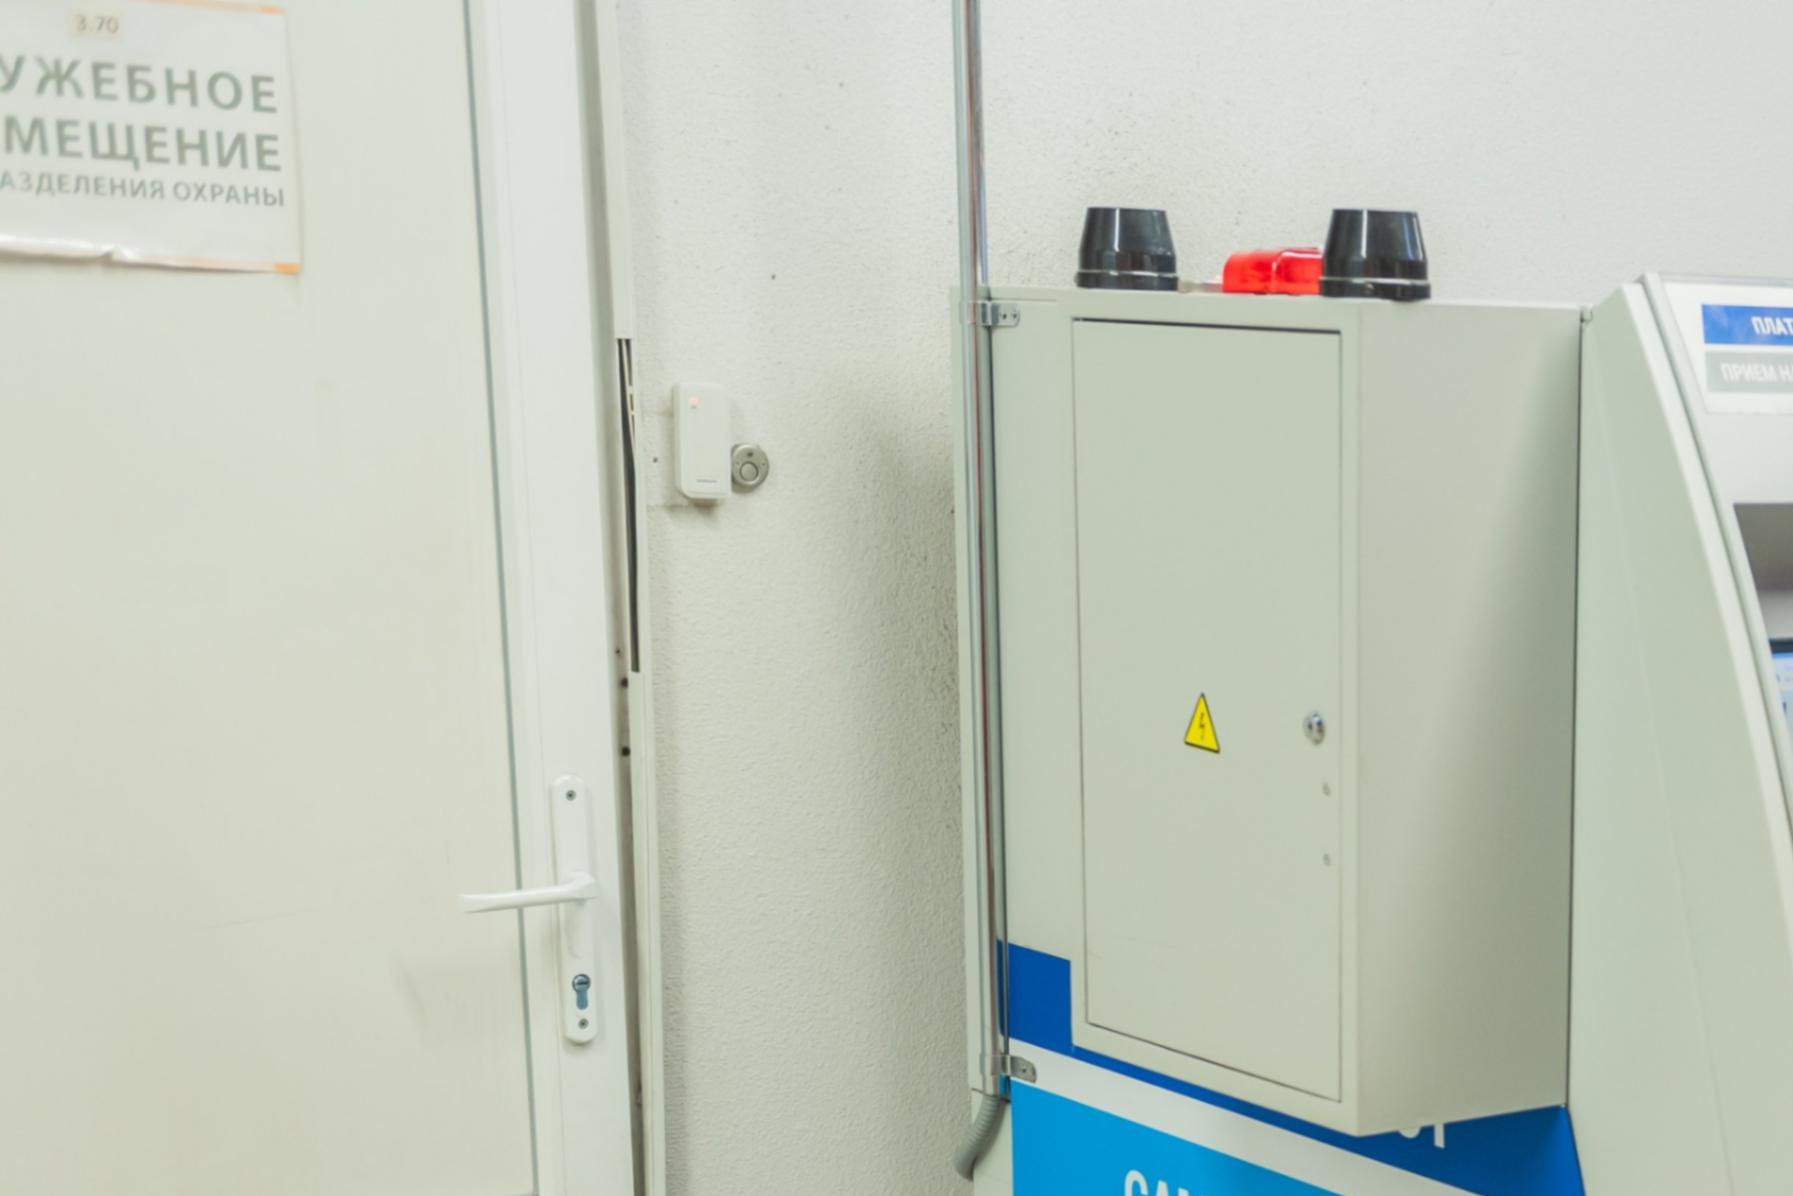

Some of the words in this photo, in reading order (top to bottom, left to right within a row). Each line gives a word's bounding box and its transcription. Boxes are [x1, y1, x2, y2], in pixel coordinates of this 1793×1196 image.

[3, 115, 283, 173] МЕЩЕНИЕ
[173, 181, 285, 208] ОХРАНЫ
[1720, 361, 1776, 385] ПРИЕМ
